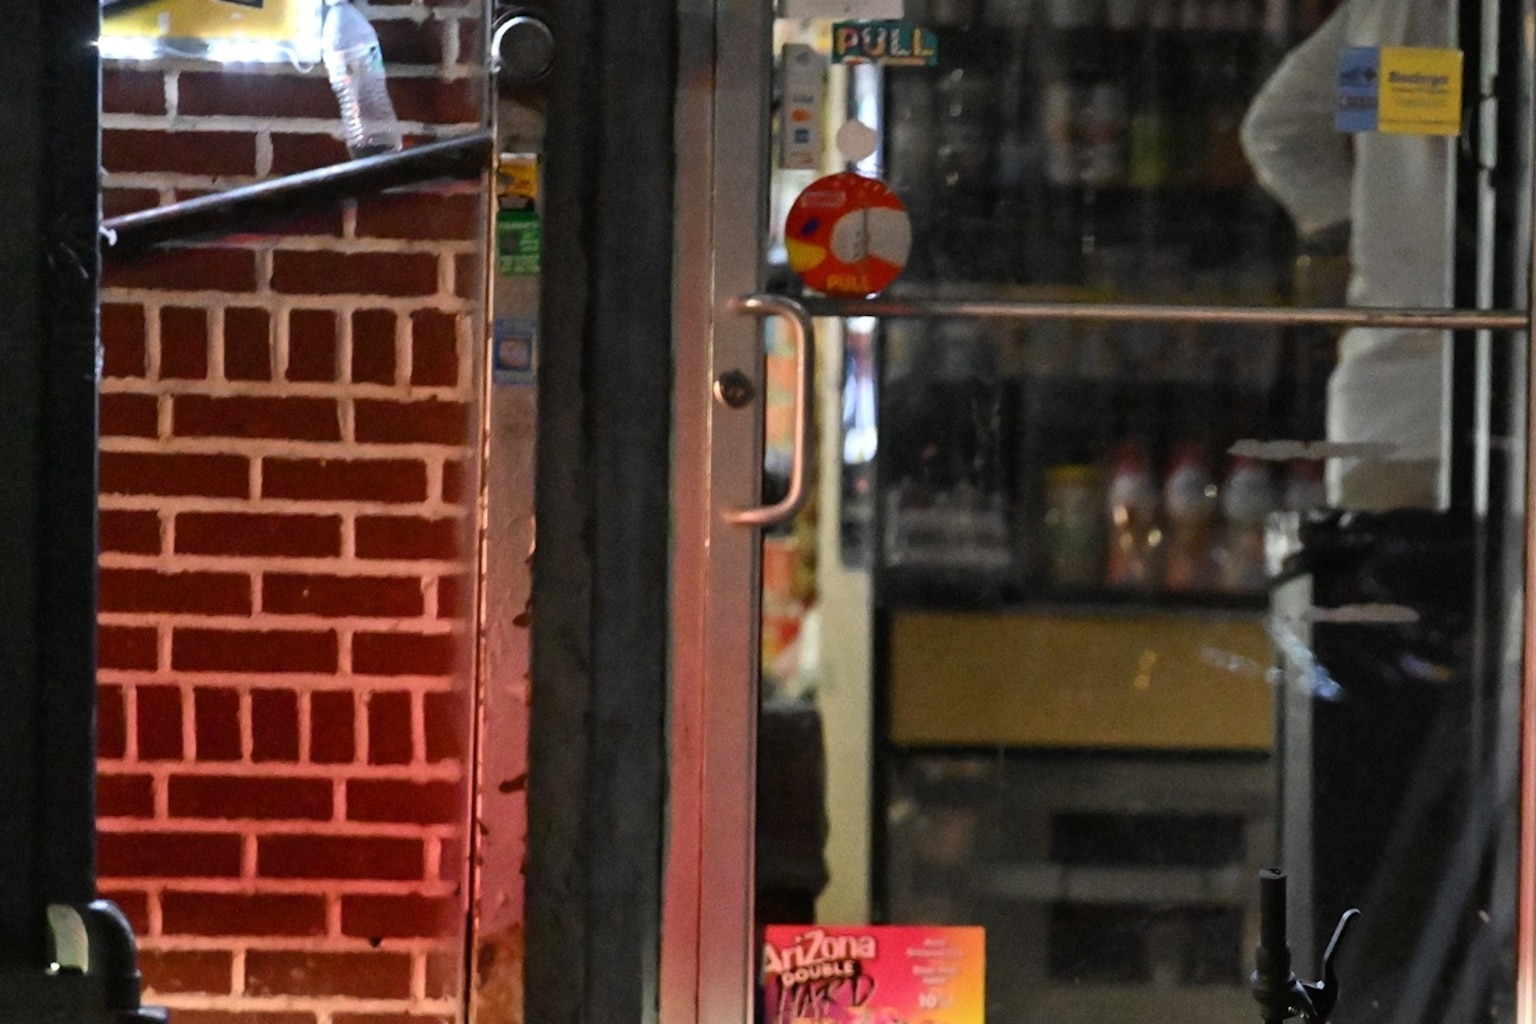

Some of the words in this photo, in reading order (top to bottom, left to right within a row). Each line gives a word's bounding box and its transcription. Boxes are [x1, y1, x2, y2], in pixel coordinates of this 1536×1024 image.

[836, 26, 935, 57] PULL
[762, 929, 877, 975] AriZona
[781, 960, 855, 989] DOUBLE
